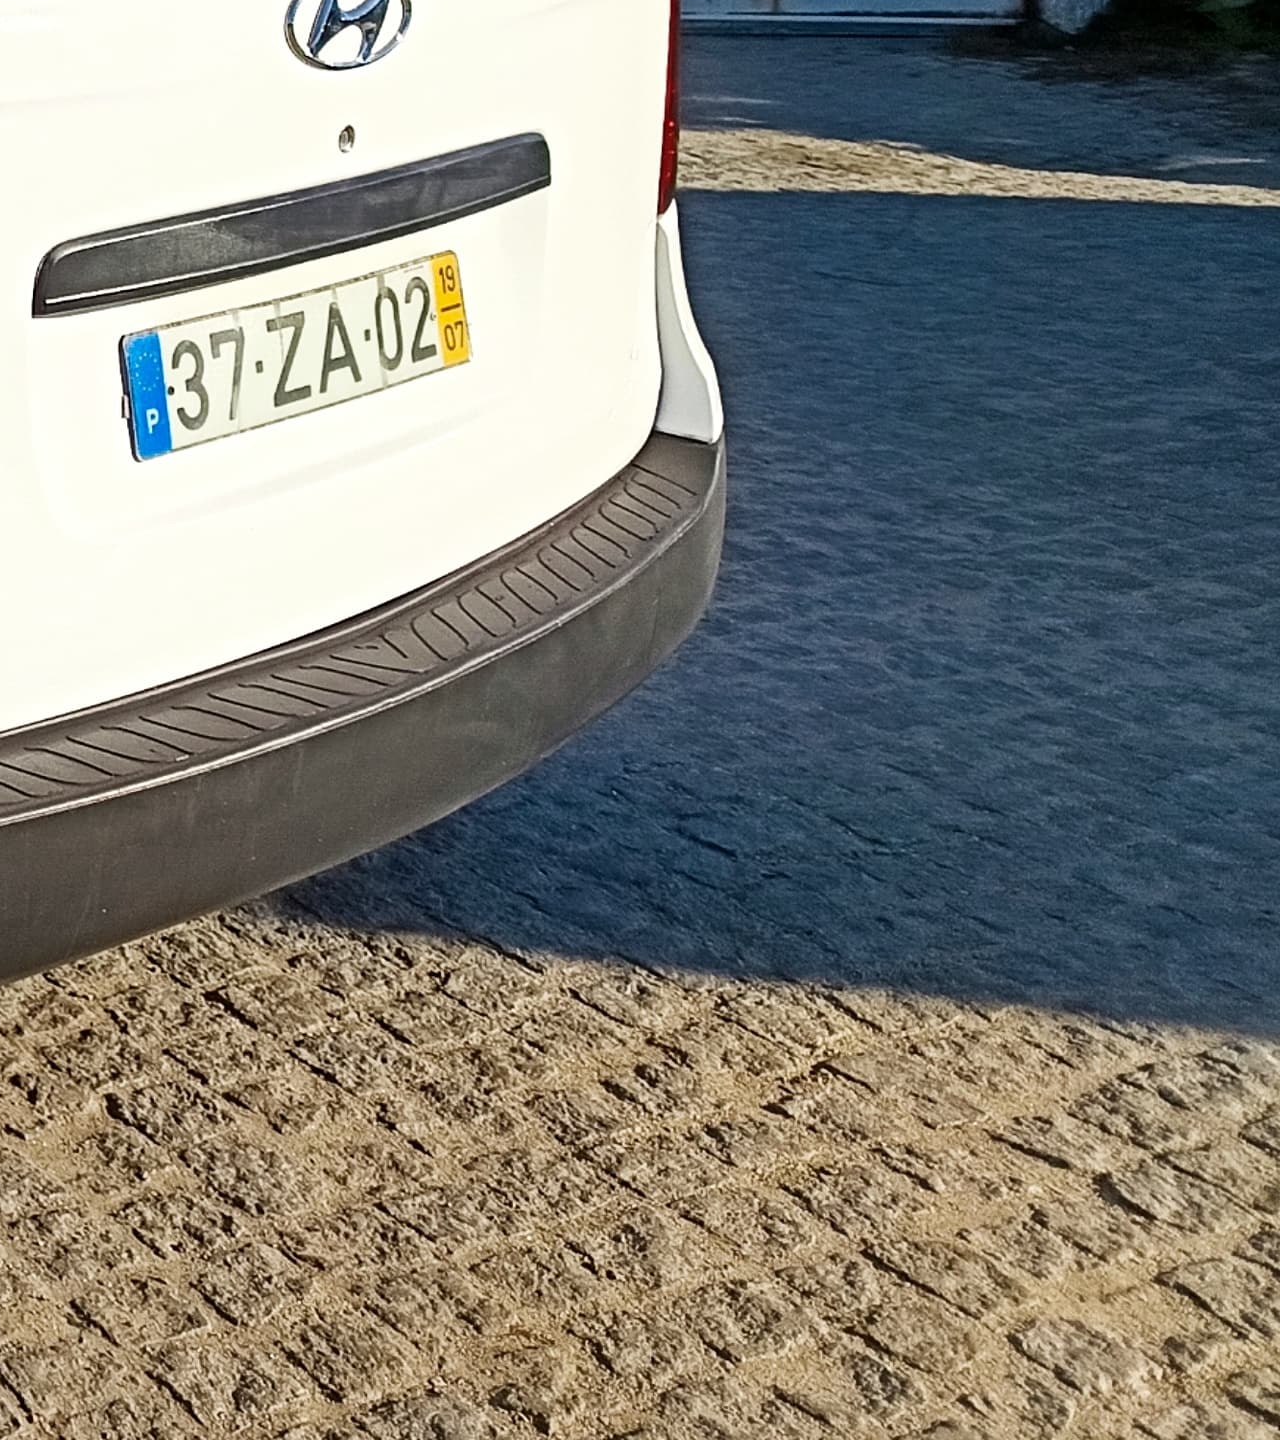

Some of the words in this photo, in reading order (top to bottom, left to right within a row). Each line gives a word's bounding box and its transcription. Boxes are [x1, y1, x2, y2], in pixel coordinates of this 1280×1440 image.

[439, 265, 456, 294] 19
[444, 320, 464, 351] 07
[146, 408, 159, 434] P
